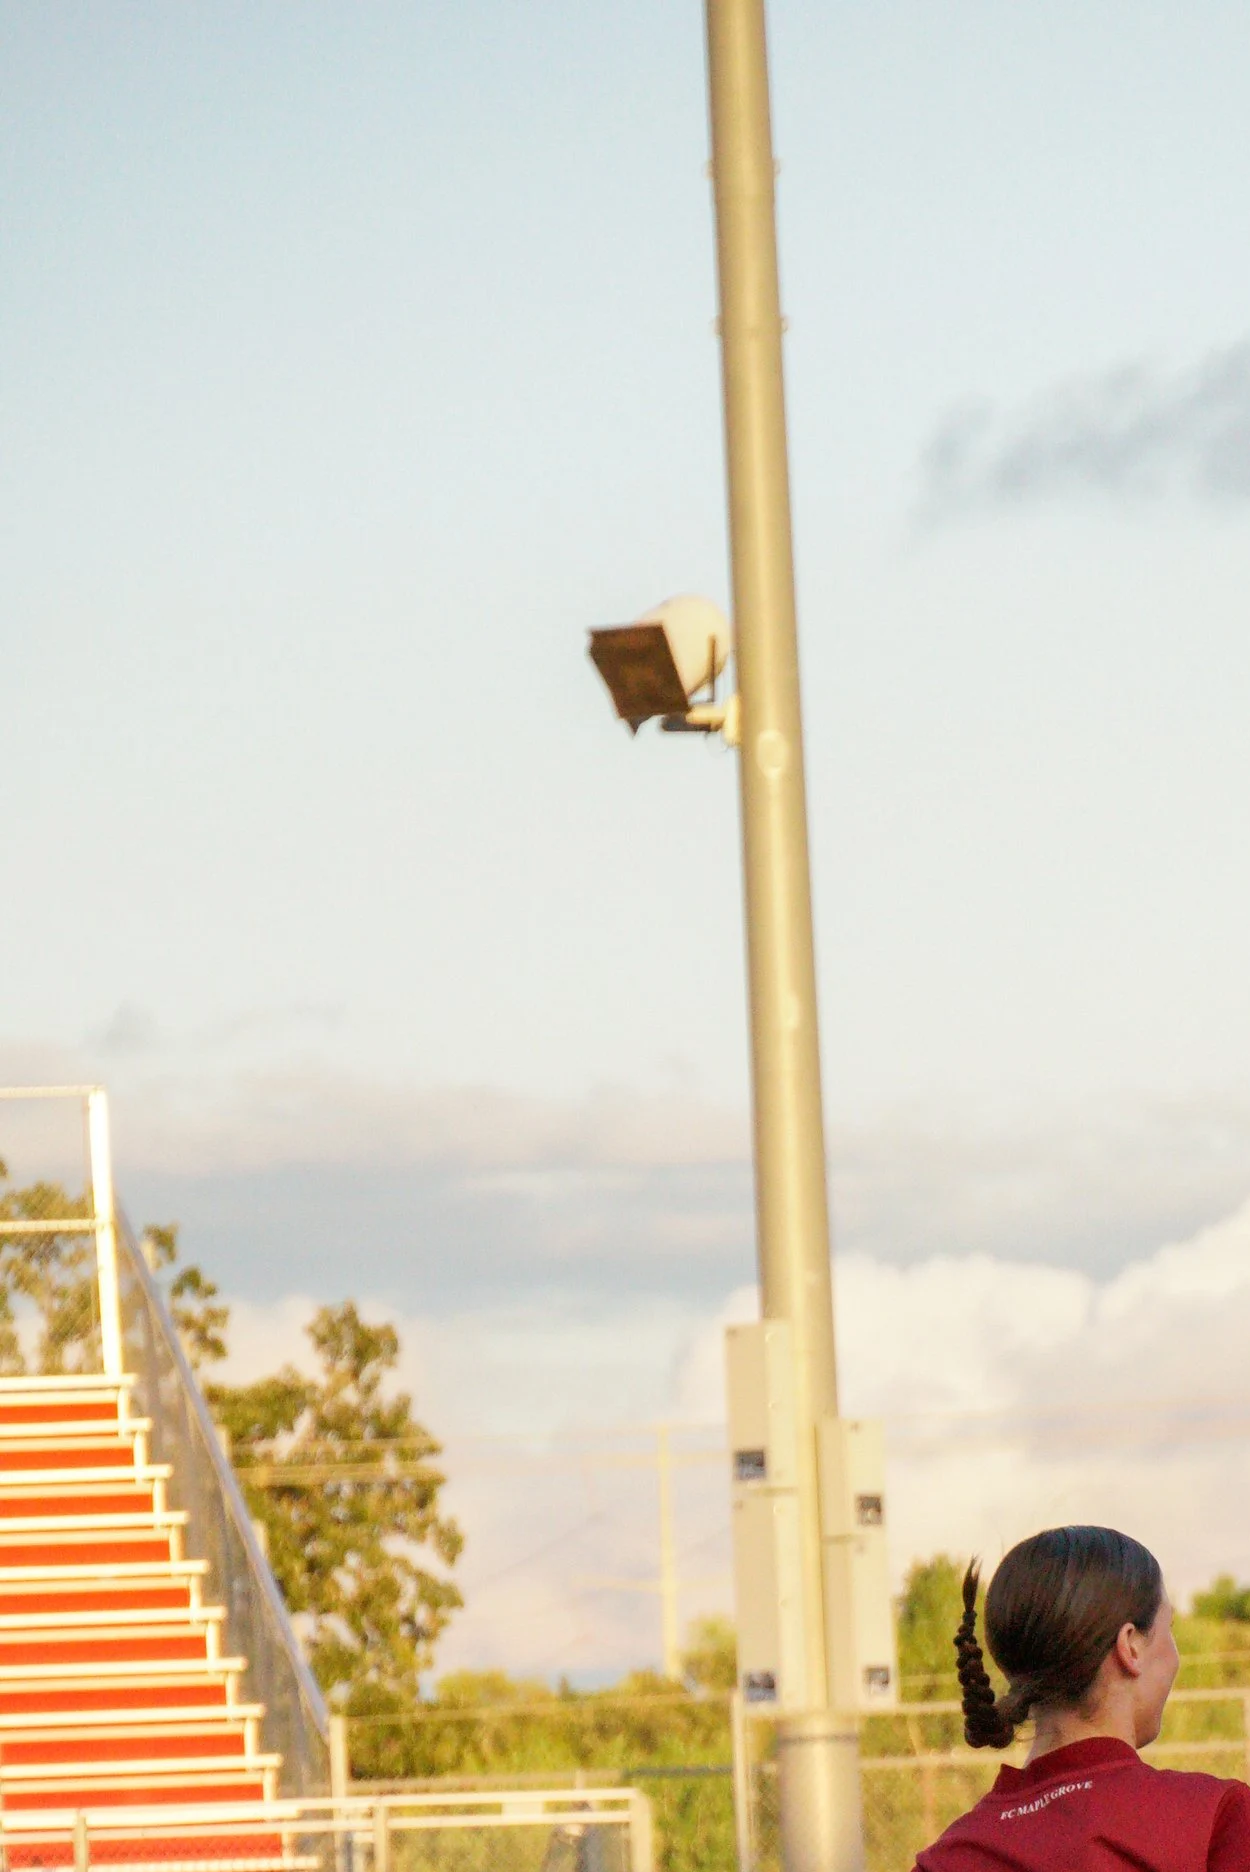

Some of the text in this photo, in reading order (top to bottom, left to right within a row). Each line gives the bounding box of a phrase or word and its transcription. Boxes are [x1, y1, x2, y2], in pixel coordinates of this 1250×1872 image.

[1000, 1780, 1093, 1820] FC MAPLE GROVE
